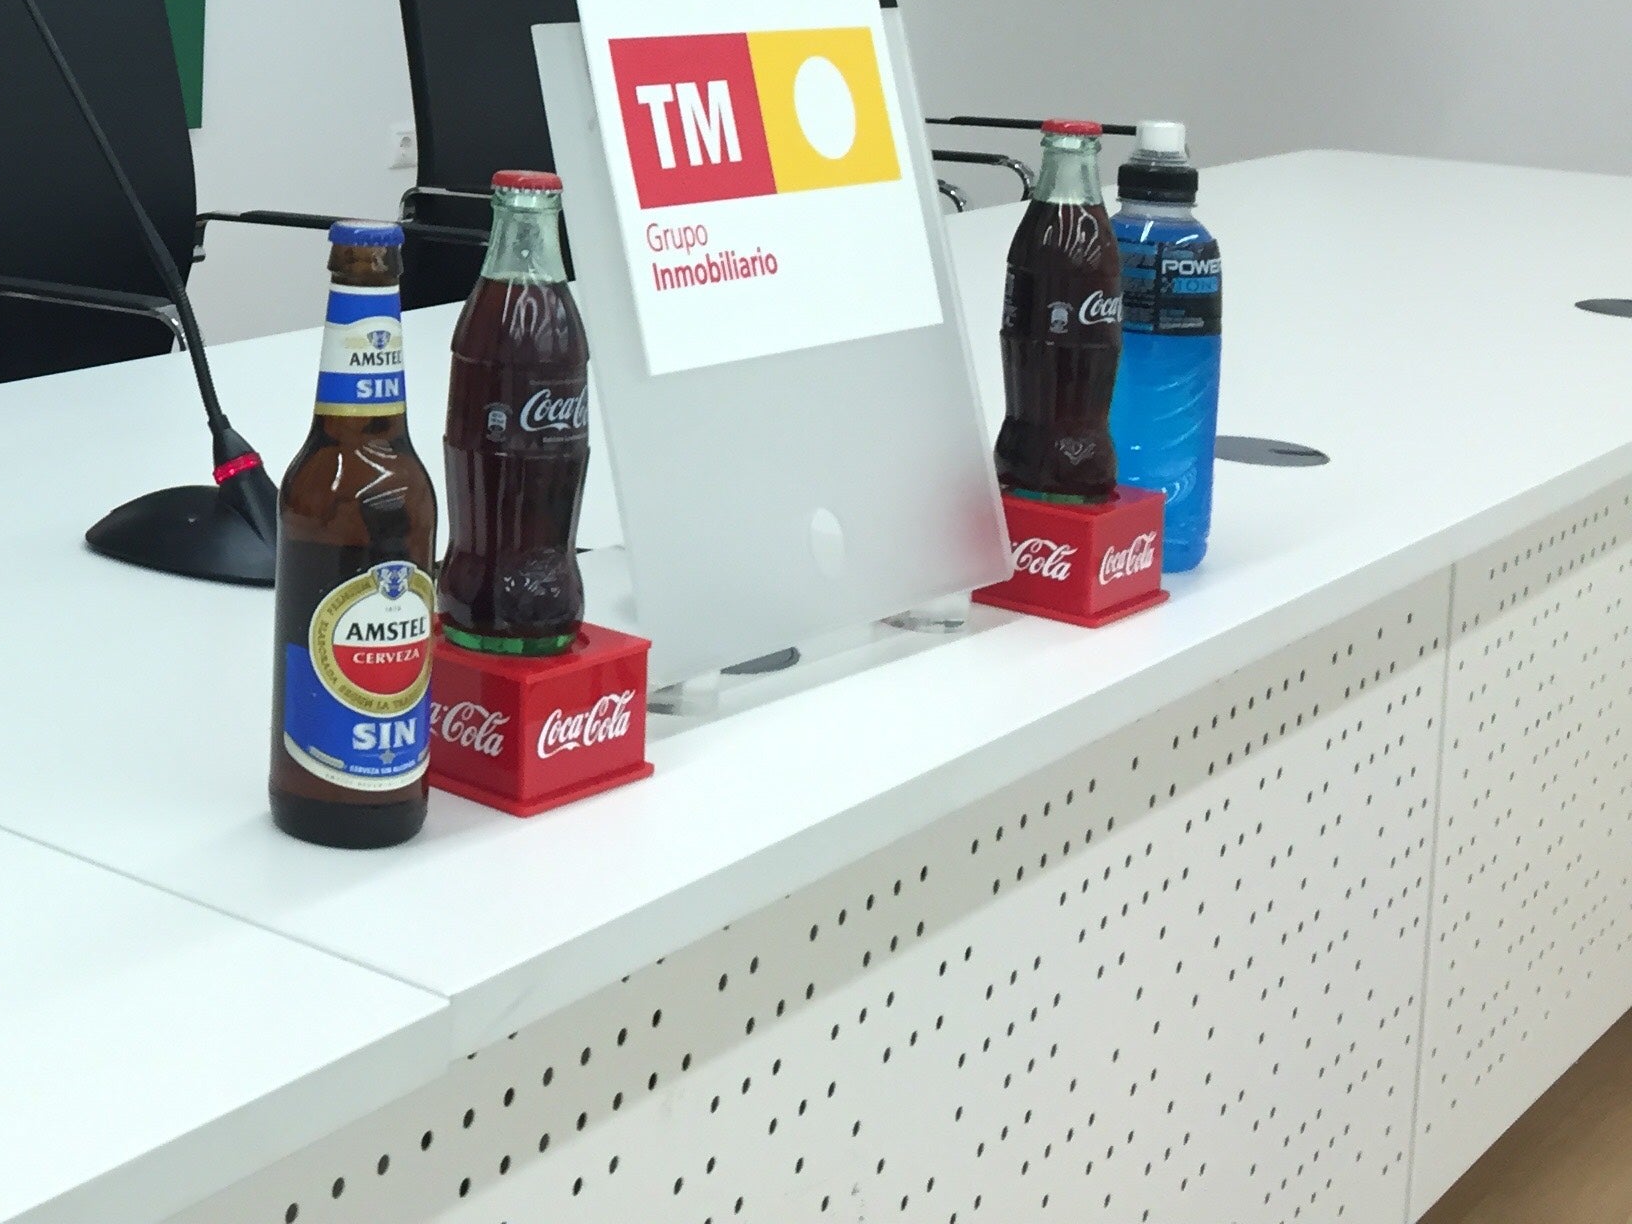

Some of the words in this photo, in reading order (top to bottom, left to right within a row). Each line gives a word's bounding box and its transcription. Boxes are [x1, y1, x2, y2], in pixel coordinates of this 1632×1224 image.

[635, 79, 743, 170] TM
[645, 222, 709, 256] Grupo
[651, 247, 779, 292] Inmobiliario
[1161, 258, 1221, 275] POWE
[356, 378, 400, 399] SIN
[345, 616, 427, 642] AMSTEL
[352, 648, 421, 664] CERVEZA
[352, 717, 417, 751] SIN
[537, 689, 636, 760] Coca-Cola
